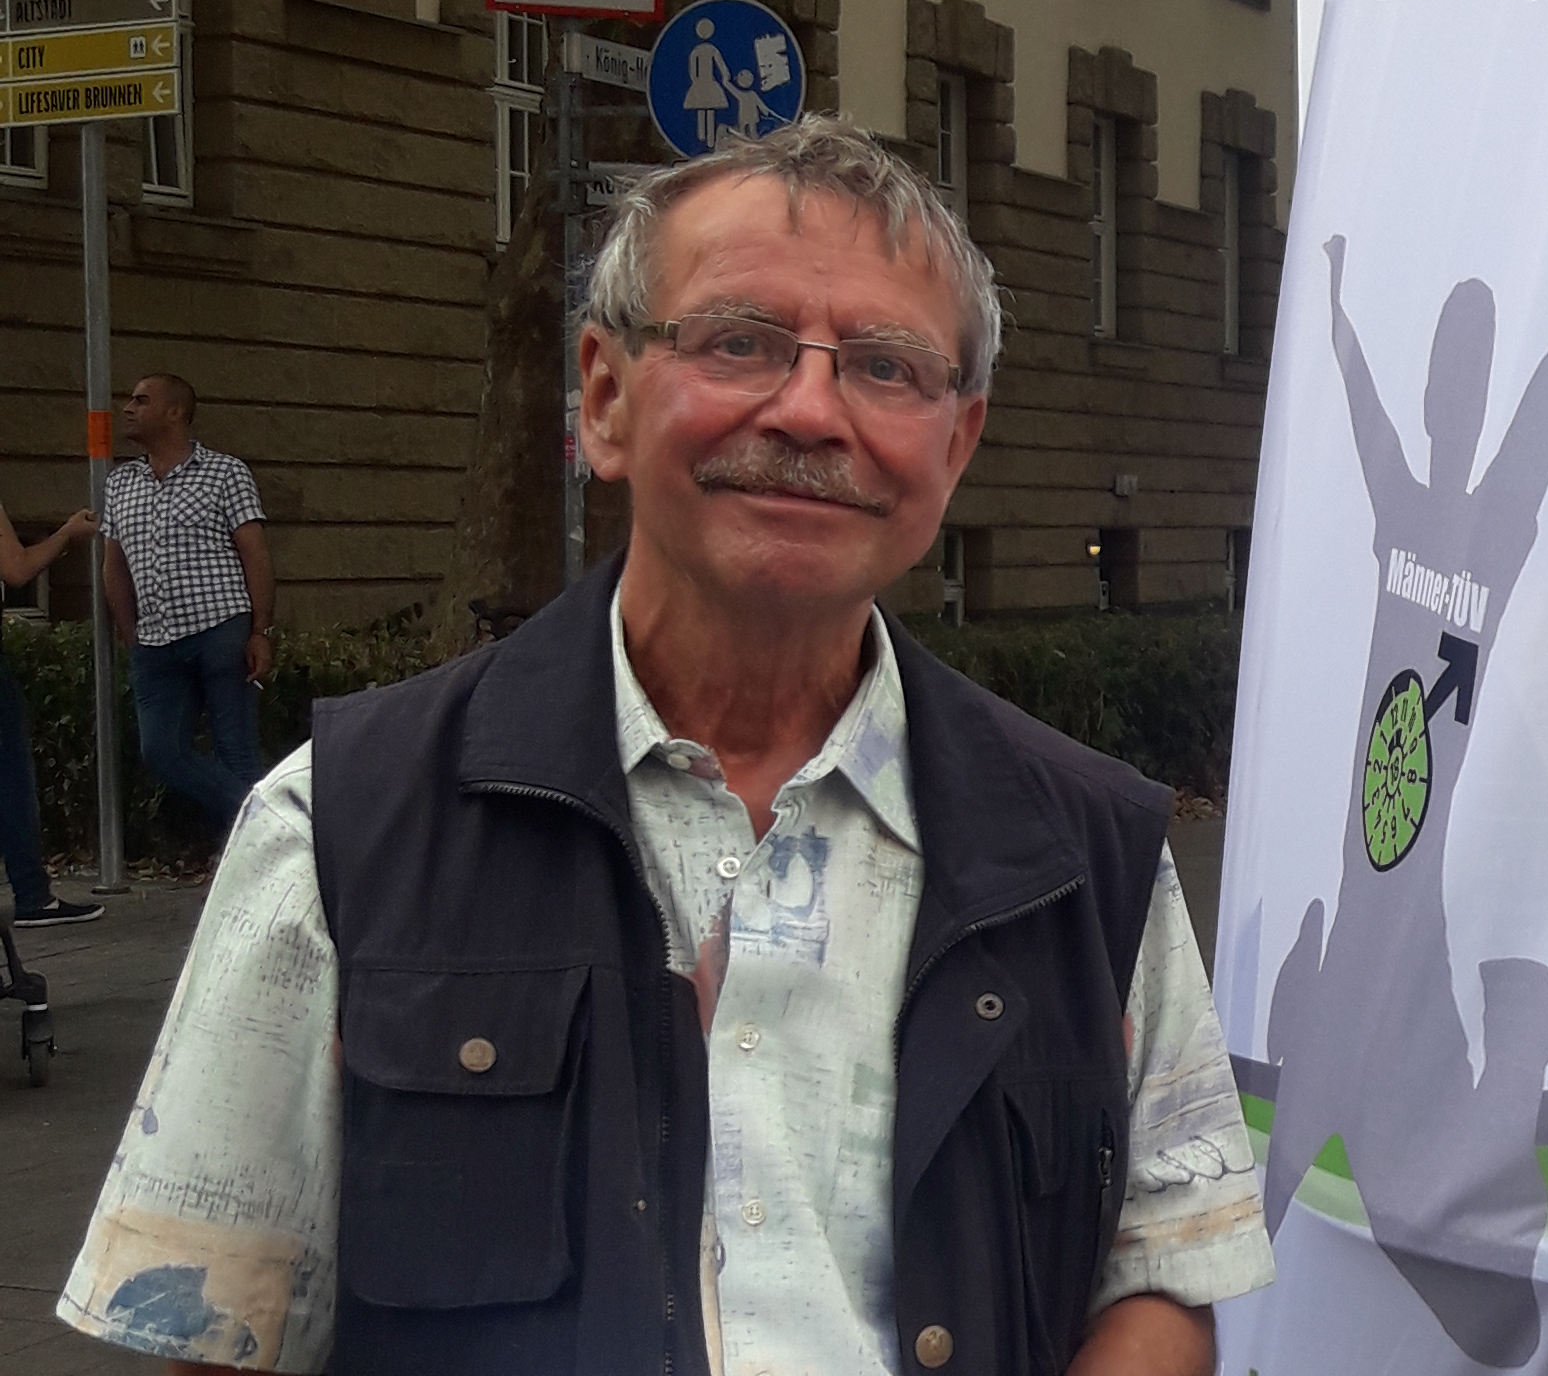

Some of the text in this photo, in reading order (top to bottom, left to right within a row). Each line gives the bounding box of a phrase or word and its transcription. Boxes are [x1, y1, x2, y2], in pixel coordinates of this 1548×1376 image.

[18, 45, 45, 69] CITY
[19, 83, 142, 115] LIFESAVER BRUNNEN
[1386, 547, 1490, 634] Männer-TÜV
